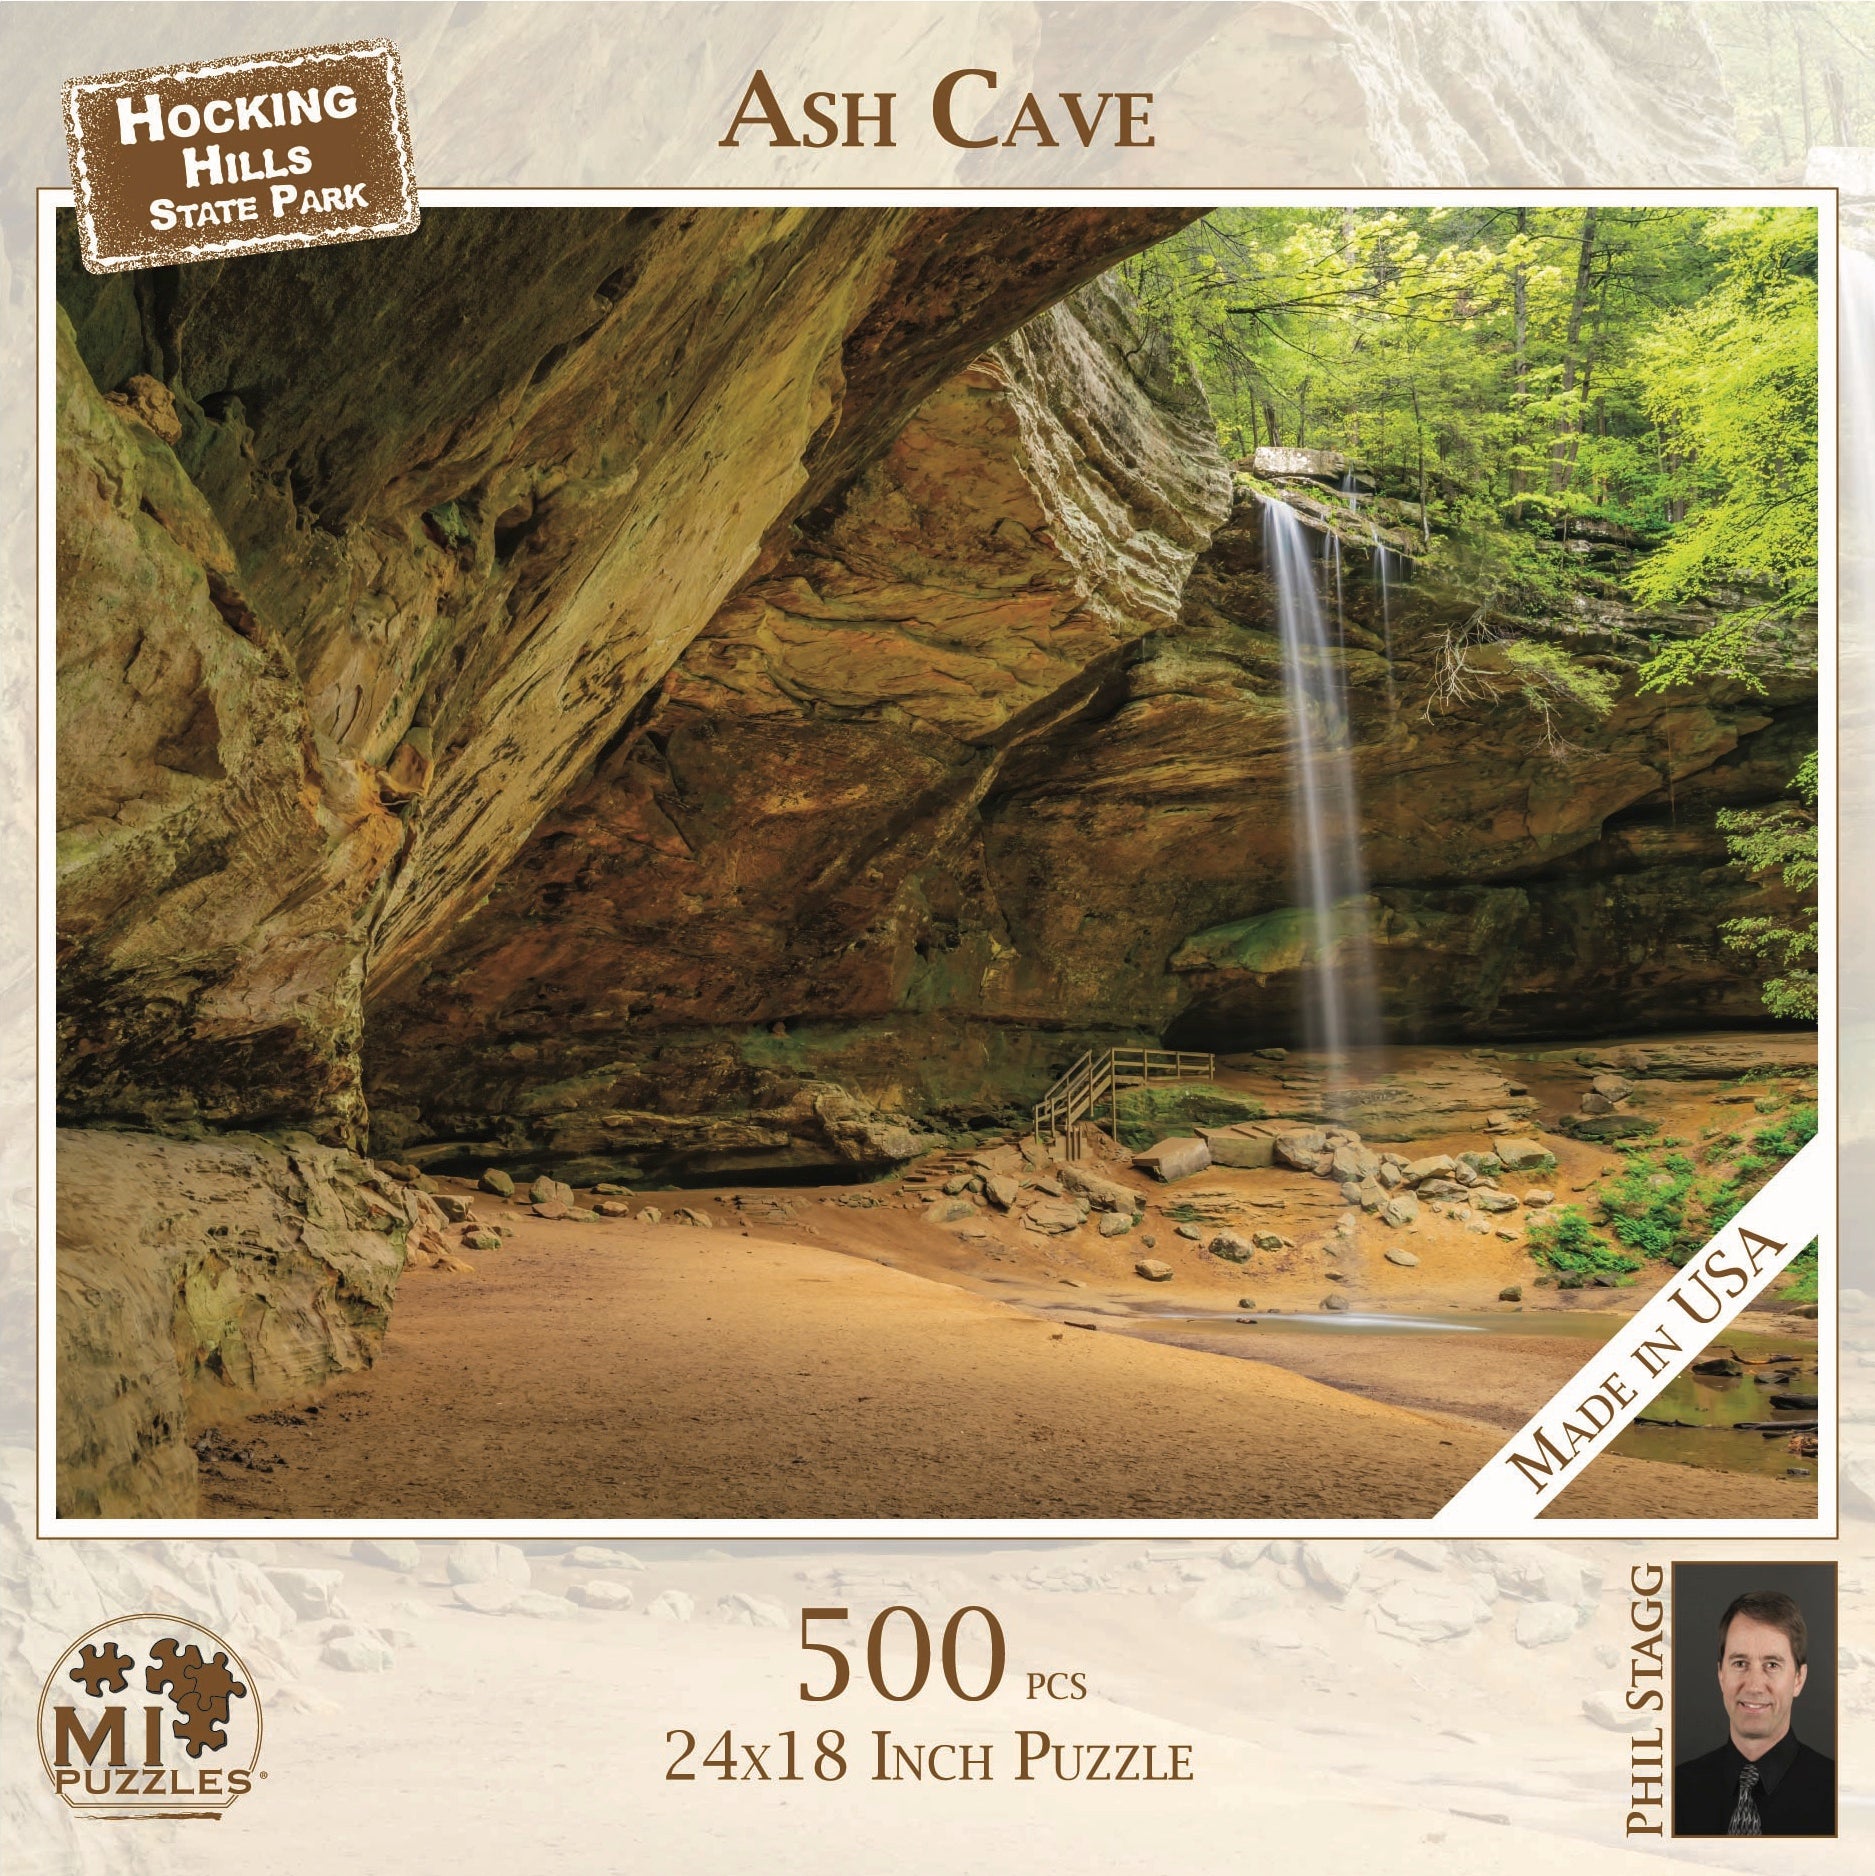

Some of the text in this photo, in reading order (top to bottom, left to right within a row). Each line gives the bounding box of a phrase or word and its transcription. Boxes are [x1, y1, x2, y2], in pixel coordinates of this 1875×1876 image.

[116, 85, 358, 145] HOCKING
[718, 68, 1156, 149] ASH CAVE
[182, 144, 312, 188] HILLS
[149, 182, 369, 231] STATE PARK
[1505, 1227, 1788, 1494] MADE IN USA
[799, 1605, 1088, 1702] 500 PCS
[1625, 1562, 1664, 1838] PHIL STAGG
[53, 1706, 164, 1767] MI
[871, 1730, 994, 1781] INCH
[1014, 1730, 1194, 1781] PUZZLE
[54, 1768, 252, 1795] PUZZLES
